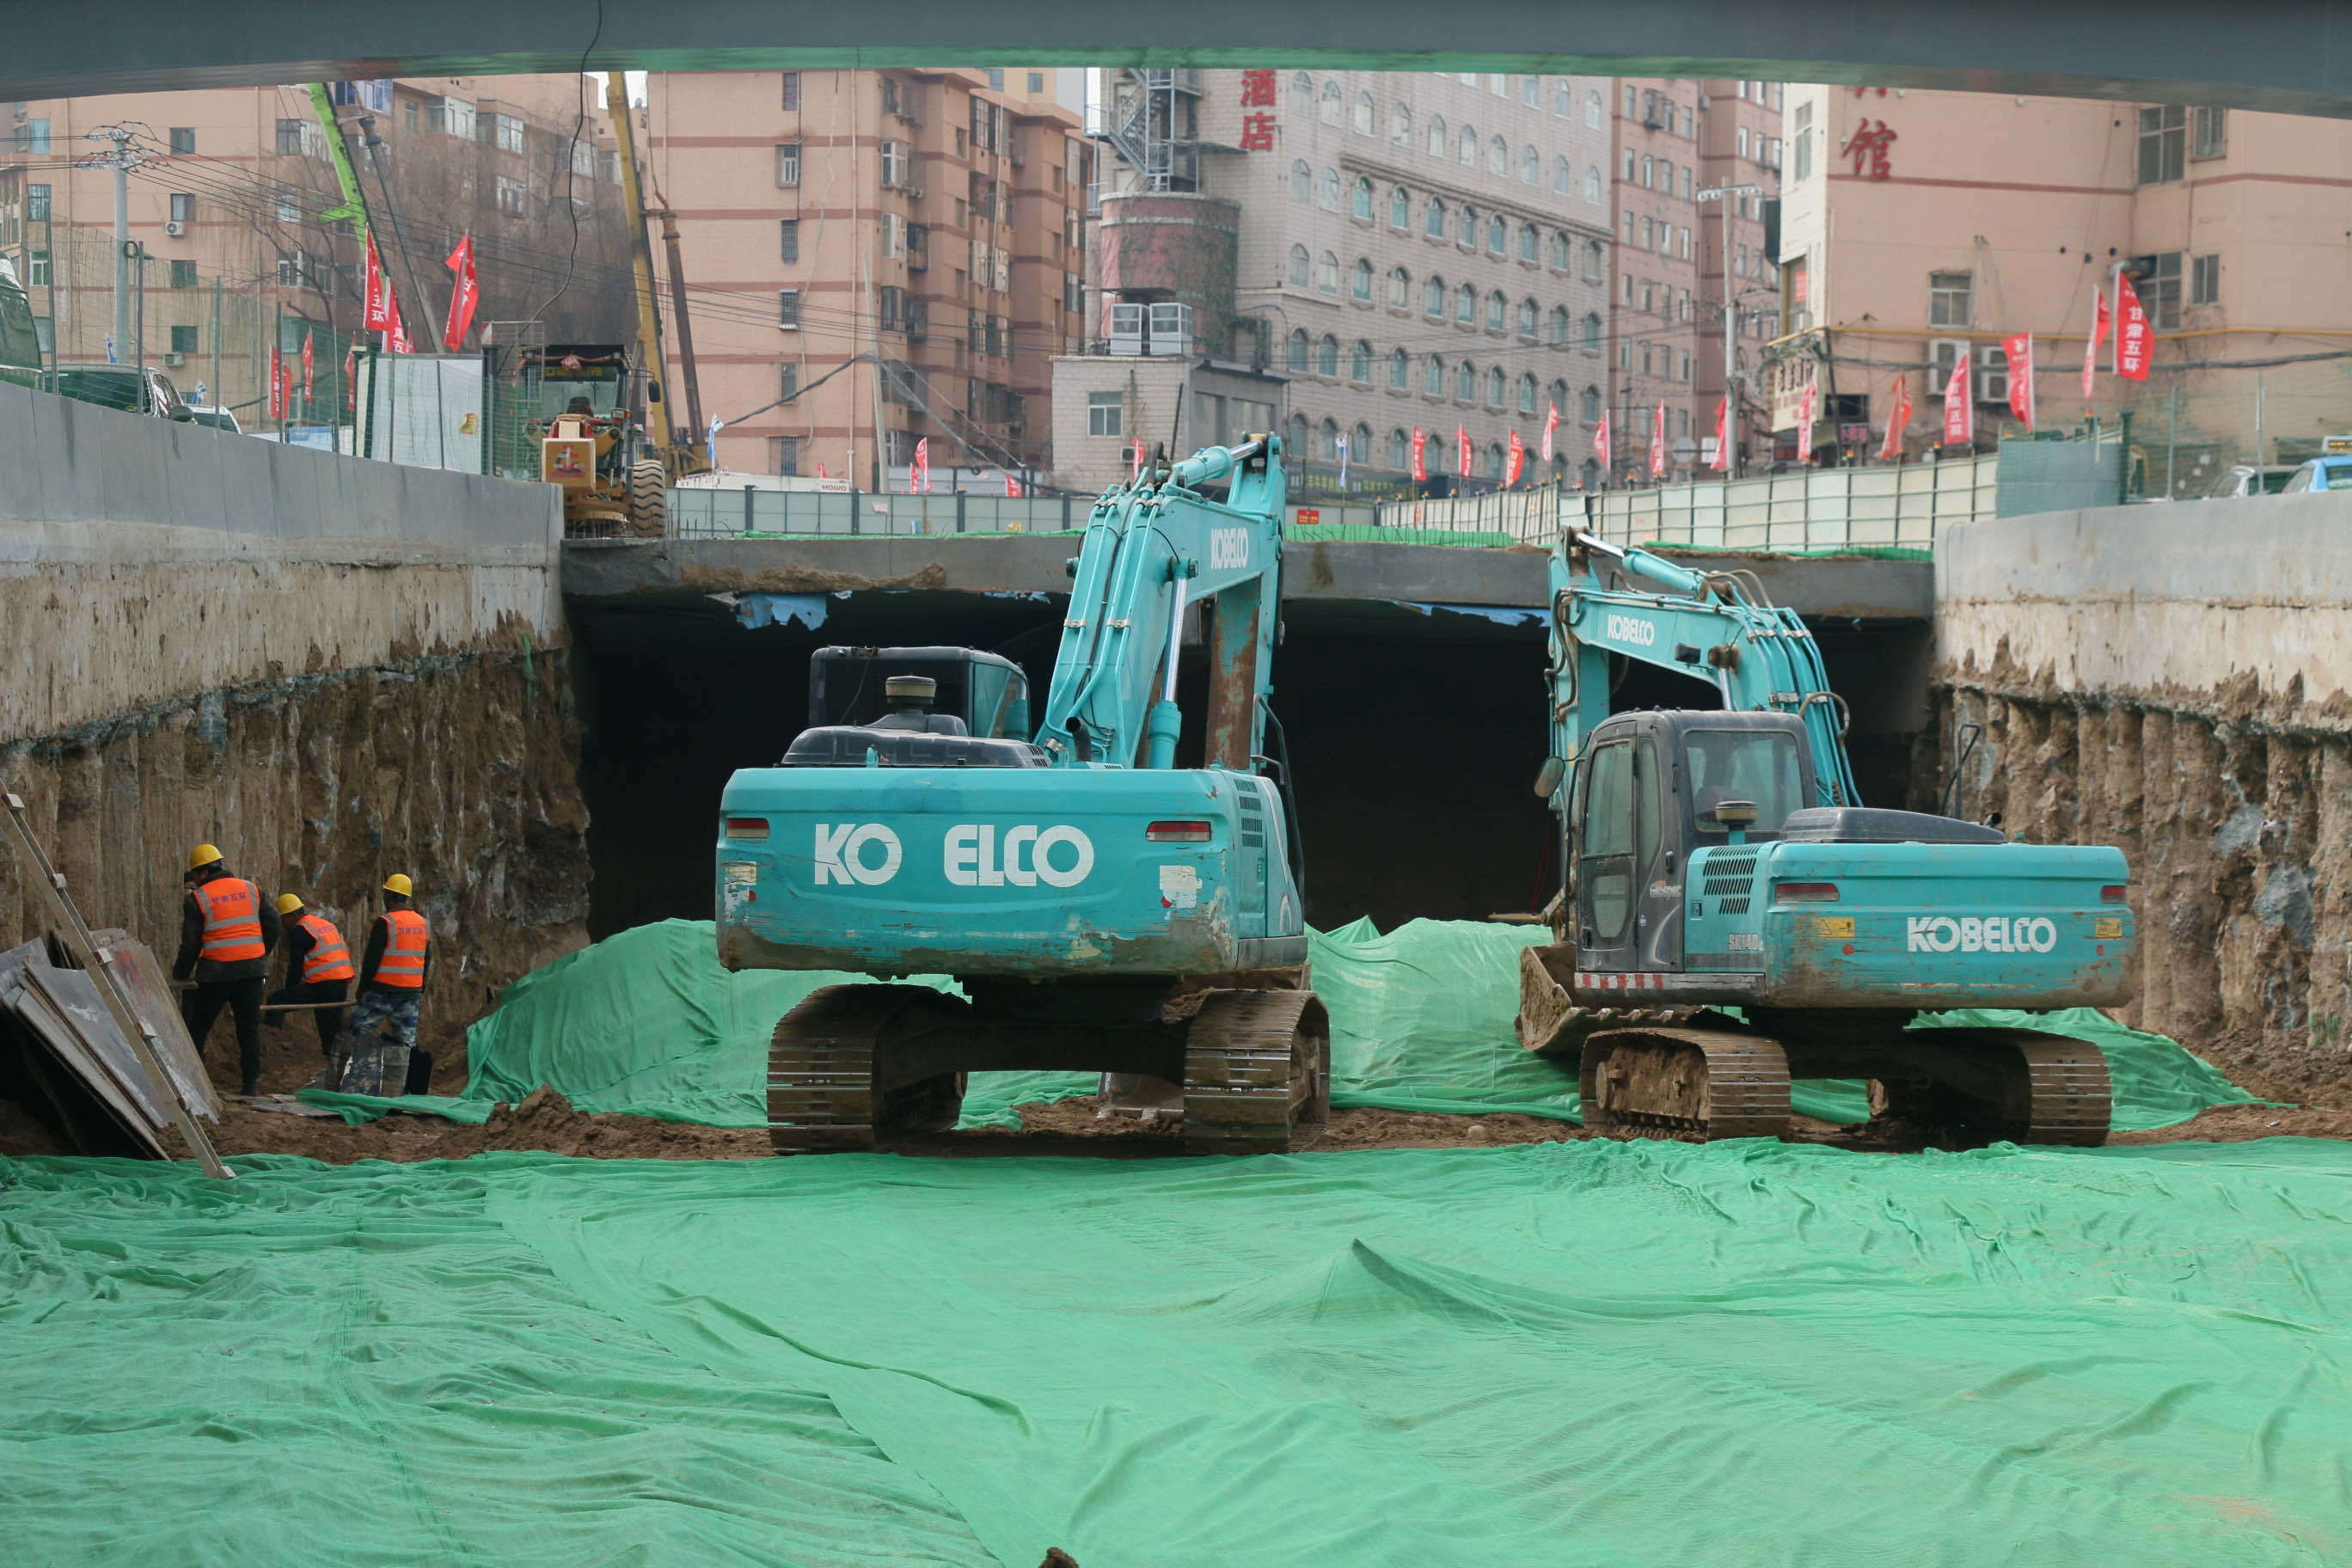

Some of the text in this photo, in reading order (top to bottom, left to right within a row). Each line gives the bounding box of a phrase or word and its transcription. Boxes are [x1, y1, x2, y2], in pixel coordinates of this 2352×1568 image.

[1240, 69, 1277, 151] 酒店
[1841, 87, 1898, 180] 馆
[1210, 527, 1249, 570] KOBELCO
[1607, 614, 1655, 646] KOBELCO
[1907, 916, 2057, 953] KOBELCO
